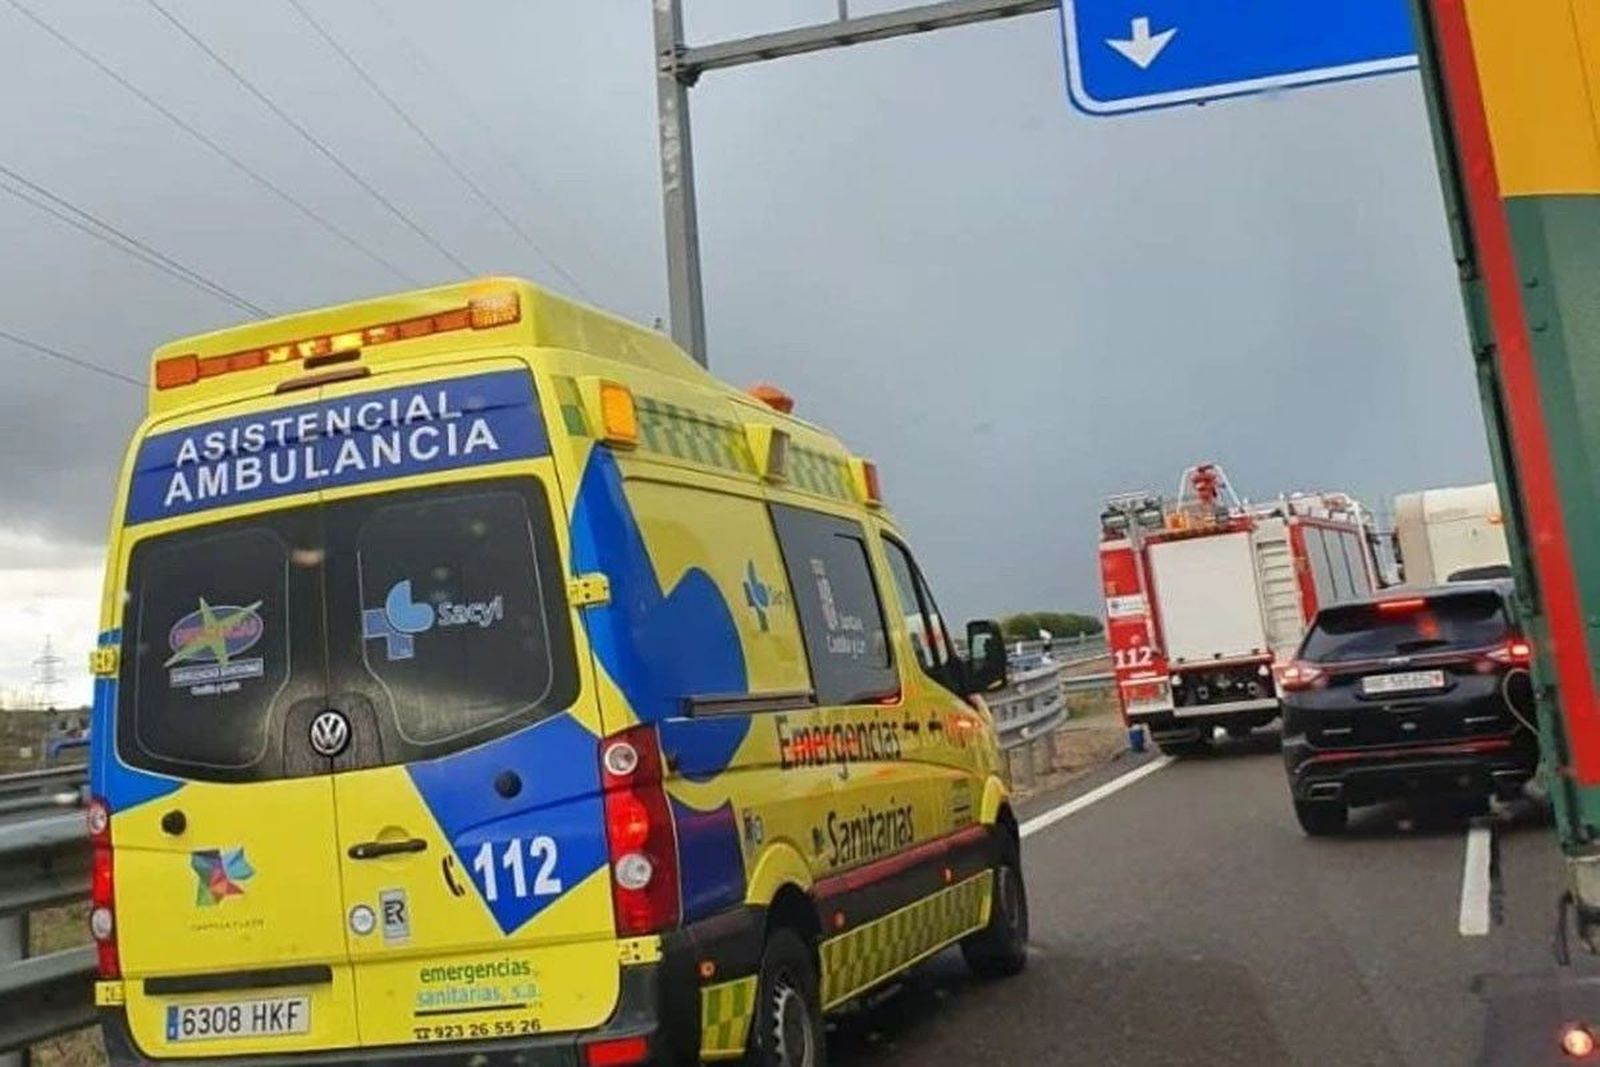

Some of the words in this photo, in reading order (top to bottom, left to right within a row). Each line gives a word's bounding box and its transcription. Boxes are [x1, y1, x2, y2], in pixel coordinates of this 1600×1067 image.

[176, 390, 463, 467] ASISTENCIAL
[164, 418, 500, 506] AMBULANCIA
[438, 595, 503, 628] Sacyl
[1114, 646, 1153, 669] 112
[774, 709, 902, 780] Emergencias
[827, 797, 915, 867] Sanitarias
[473, 835, 562, 901] 112
[420, 958, 531, 984] emergencias
[182, 1006, 241, 1035] 6308
[252, 1001, 302, 1032] HKF
[434, 1024, 464, 1038] 923
[469, 1022, 489, 1037] 26
[495, 1021, 515, 1035] 55
